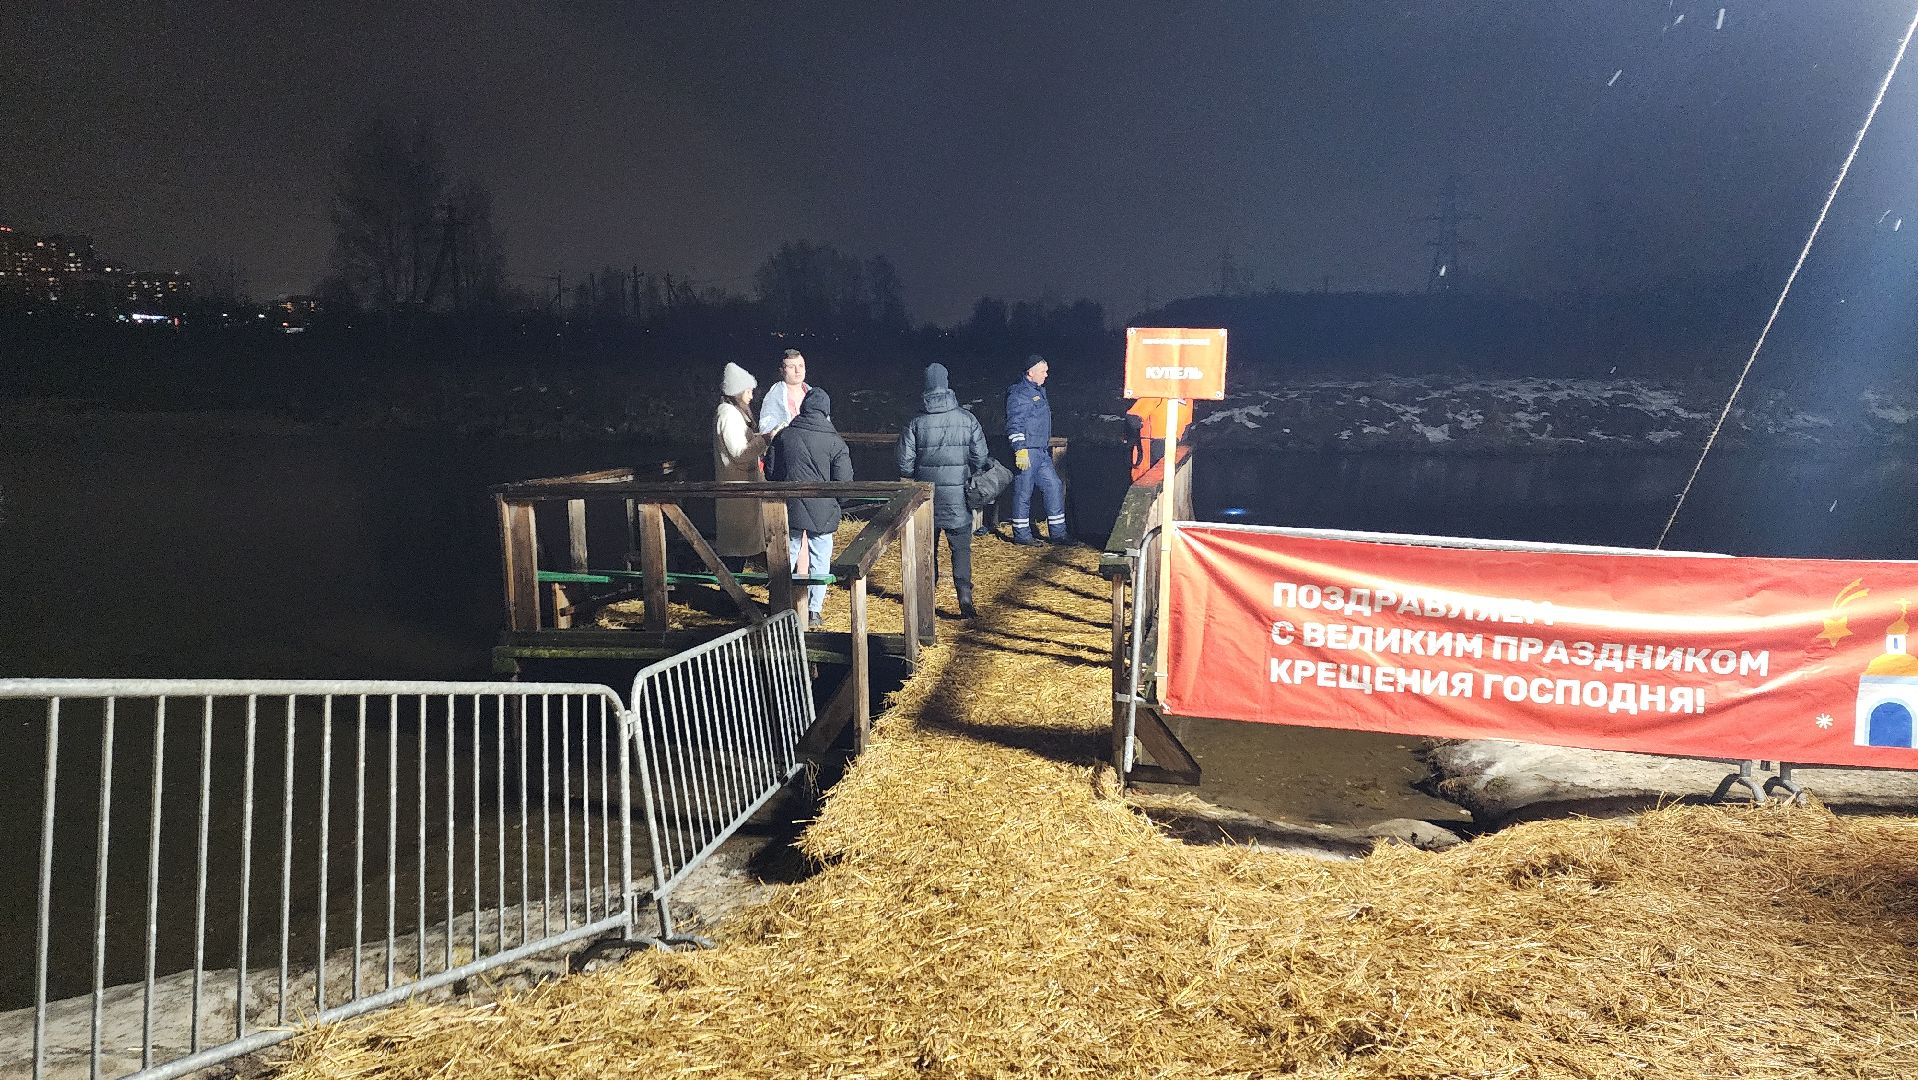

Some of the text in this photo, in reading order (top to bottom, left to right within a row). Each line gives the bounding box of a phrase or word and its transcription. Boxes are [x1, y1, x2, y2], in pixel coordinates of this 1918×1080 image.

[1145, 367, 1203, 379] КУПЕЛЬ
[1271, 621, 1770, 677] С ВЕЛИКИМ ПРАЗДНИКОМ
[1270, 658, 1706, 714] КРЕЩЕНИЯ ГОСПОДНЯ!
